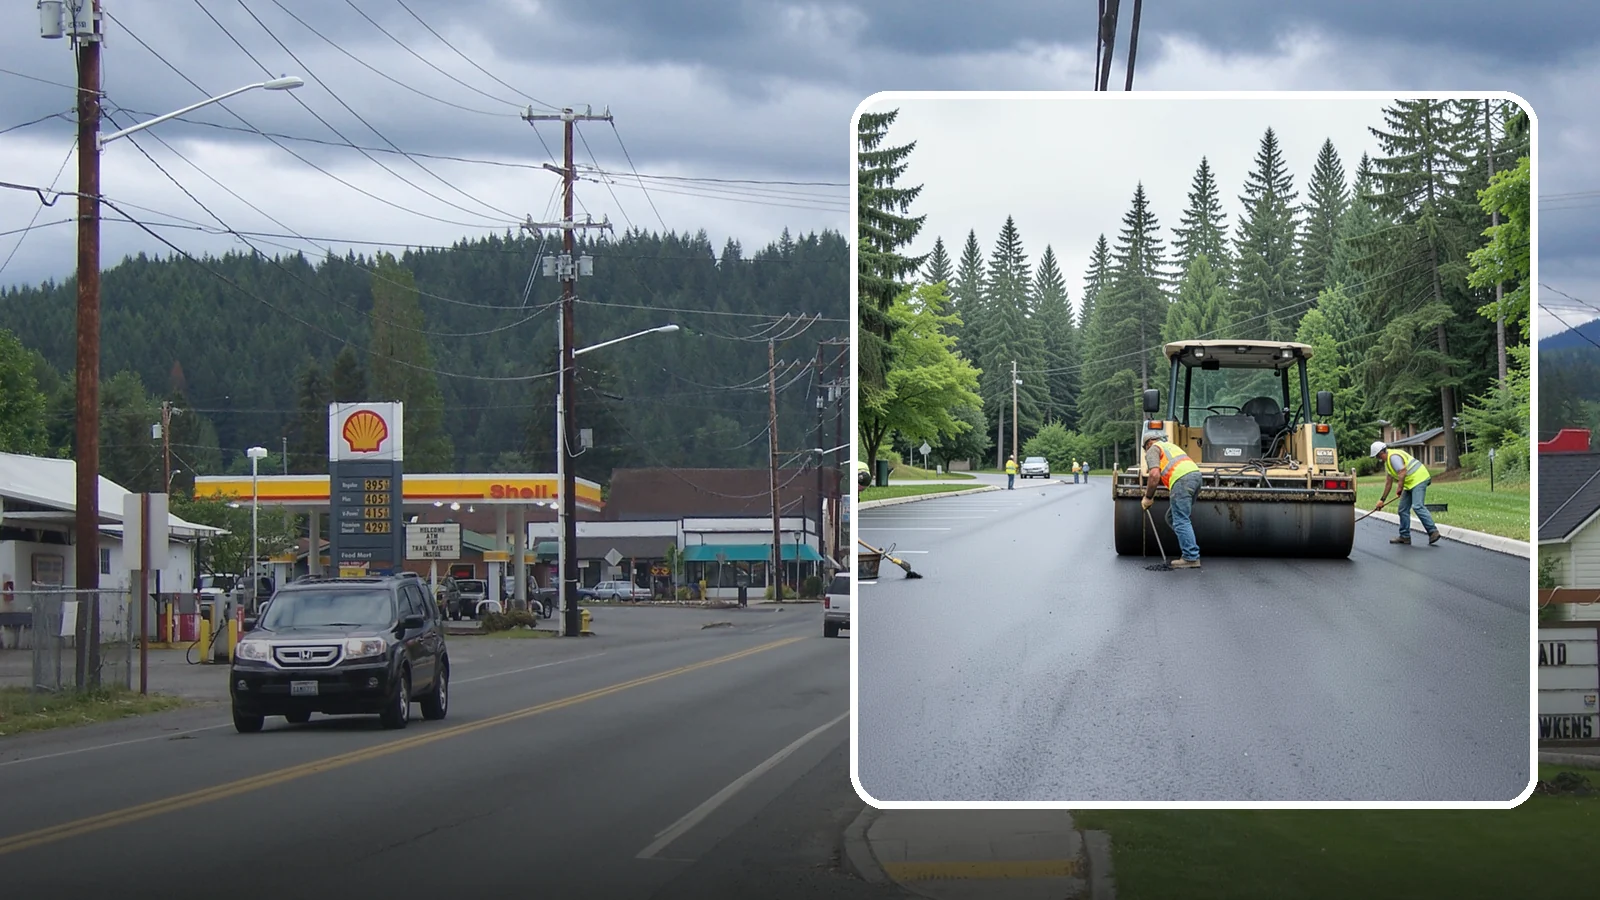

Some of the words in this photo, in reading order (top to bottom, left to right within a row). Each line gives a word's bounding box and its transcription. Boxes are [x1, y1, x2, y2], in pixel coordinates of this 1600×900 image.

[366, 480, 383, 490] 395
[490, 484, 547, 499] Shell
[366, 494, 383, 504] 405
[366, 508, 383, 518] 415
[366, 522, 383, 532] 429
